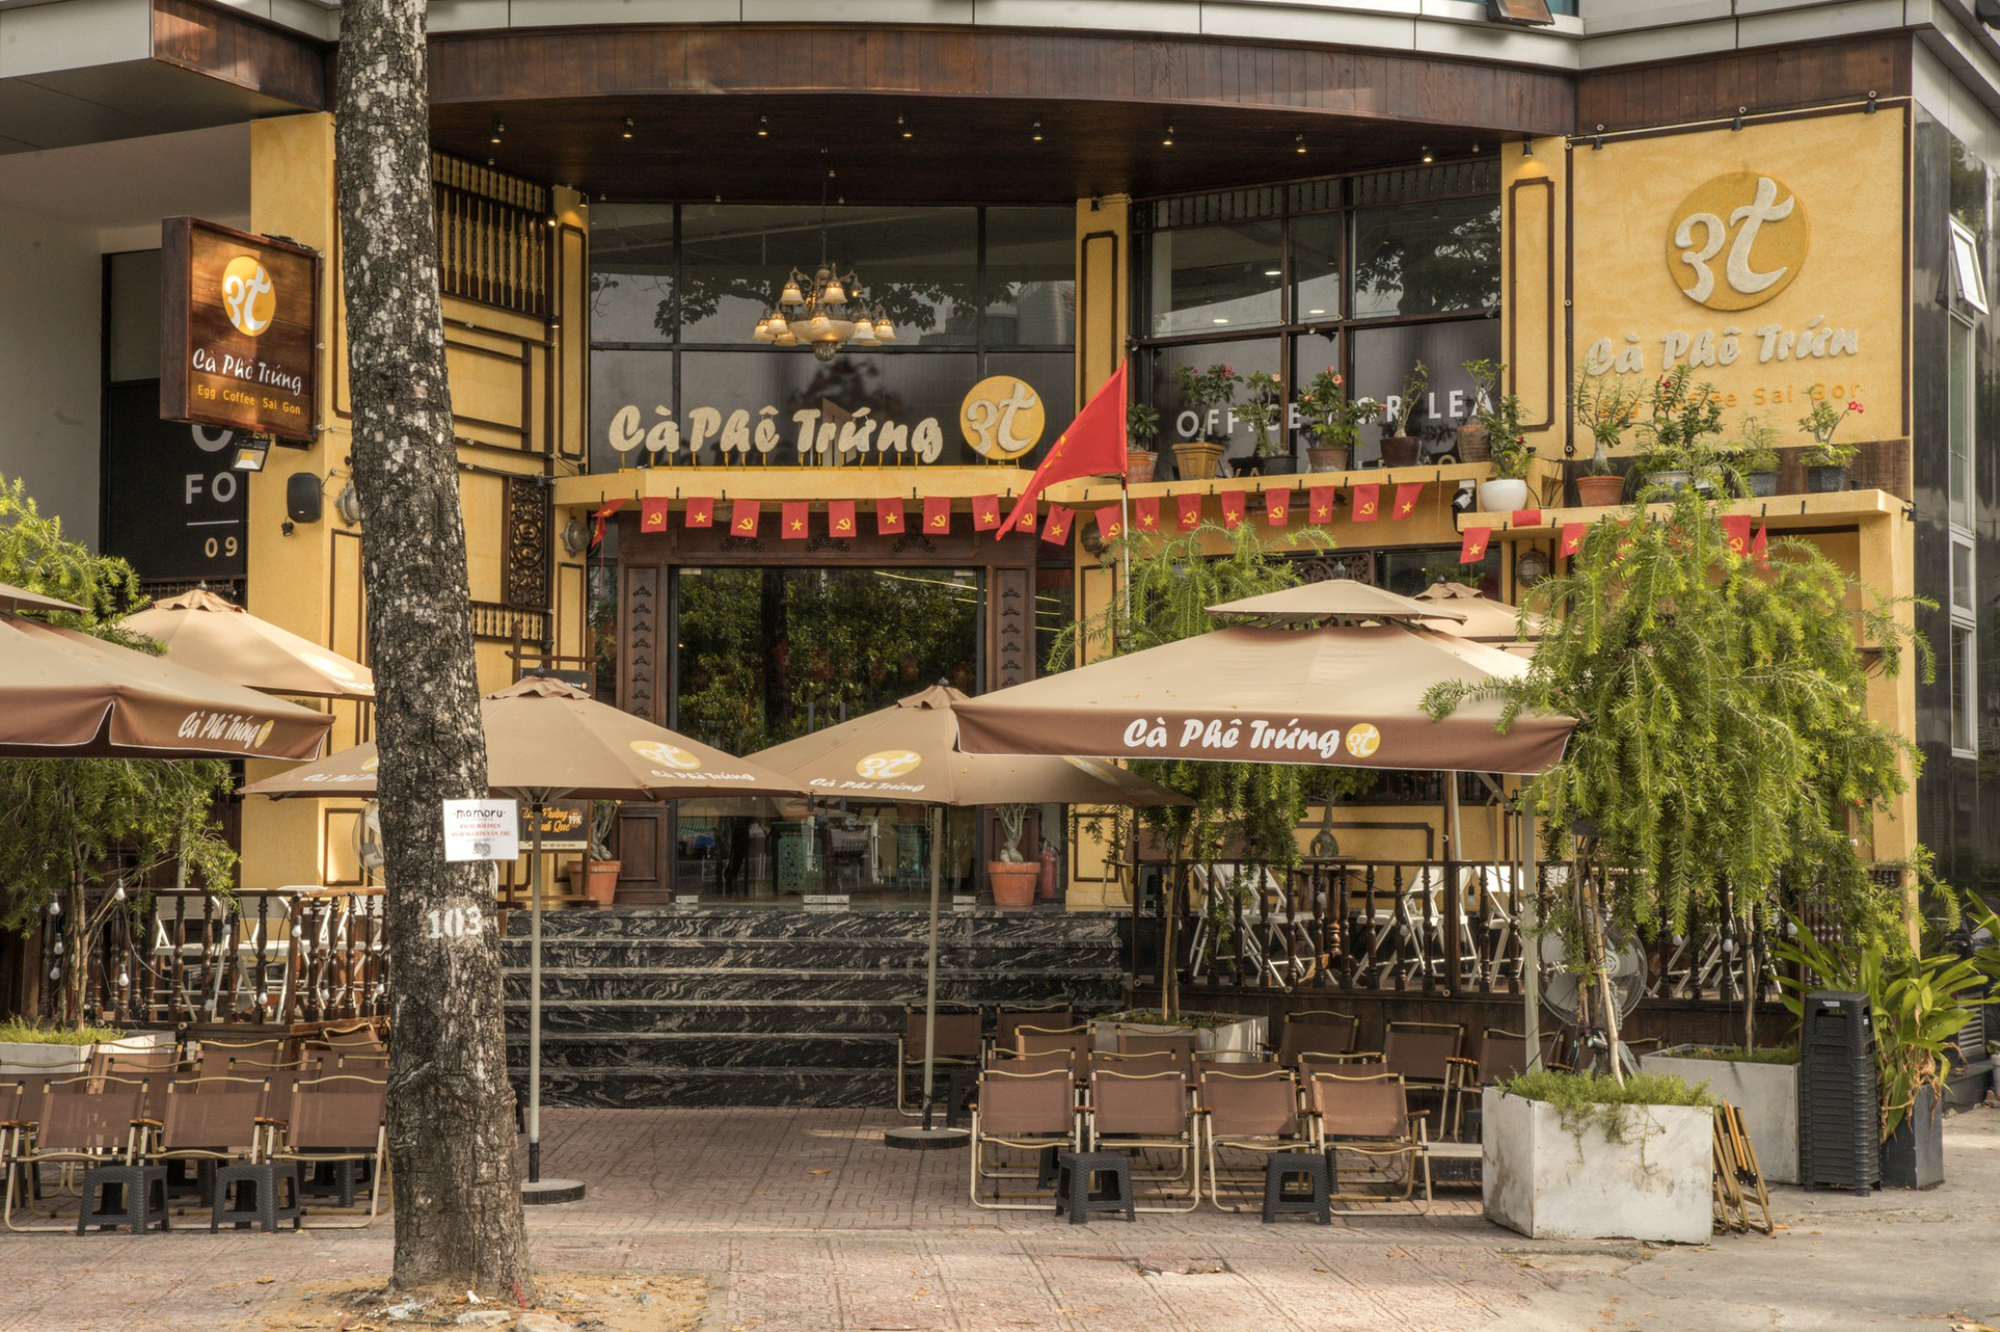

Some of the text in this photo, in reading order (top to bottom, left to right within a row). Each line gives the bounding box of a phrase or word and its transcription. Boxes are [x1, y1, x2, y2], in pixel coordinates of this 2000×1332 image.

[192, 347, 217, 373] Cà
[1585, 332, 1644, 376] Cà
[1661, 326, 1742, 372] Phê
[198, 384, 301, 415] Egg Coffee Sai Gon
[1753, 383, 1793, 406] Sai
[1327, 395, 1403, 426] OR
[608, 404, 944, 464] Cà Phê Trứng
[185, 471, 237, 505] FO
[204, 536, 239, 558] 09
[1123, 716, 1168, 748] Cà
[1179, 718, 1243, 749] Phê
[1249, 718, 1341, 759] Trứng
[456, 809, 504, 819] mamoru
[568, 814, 583, 825] 19K
[426, 904, 482, 939] 103
